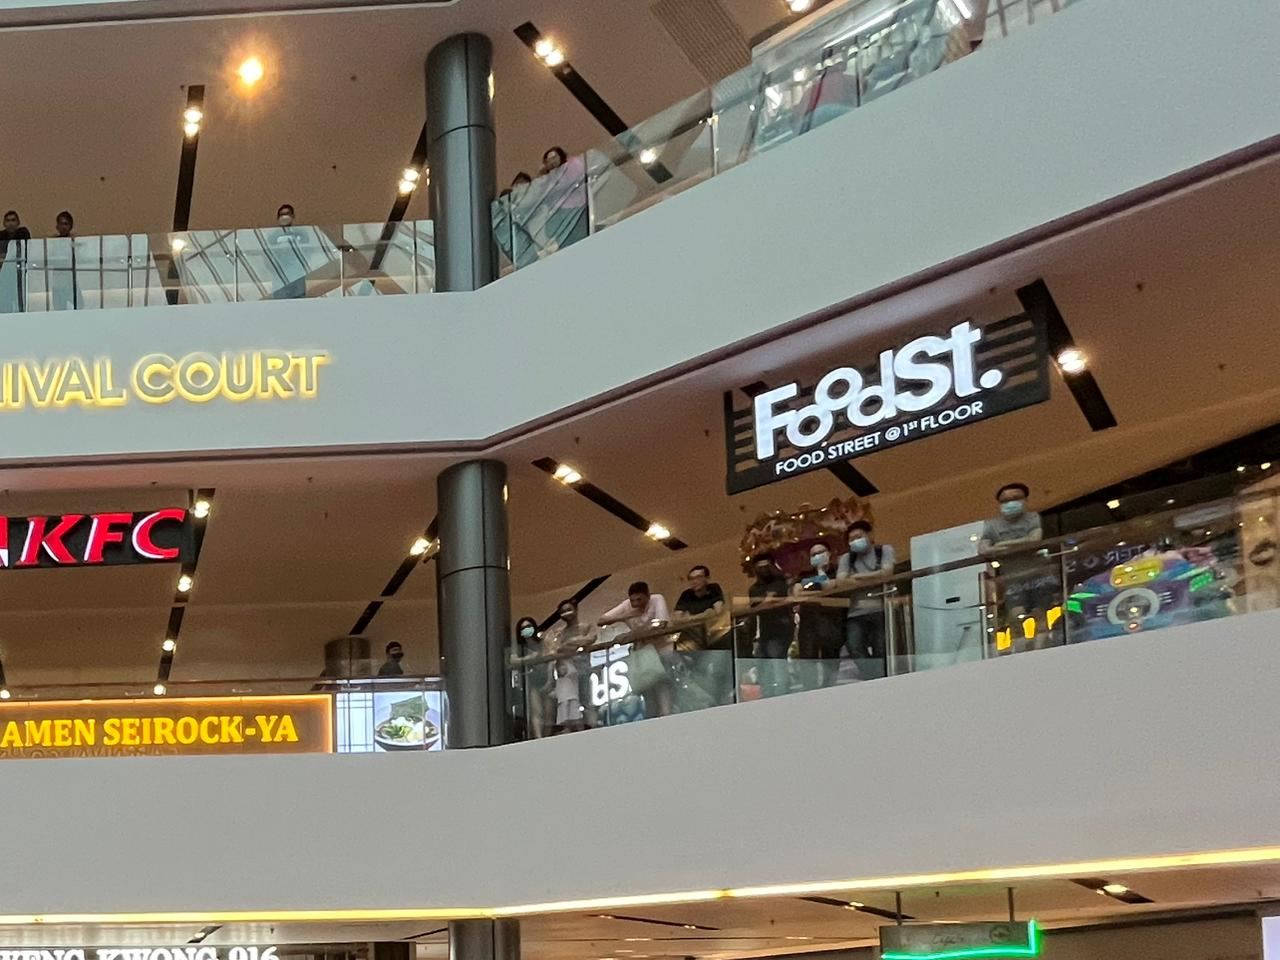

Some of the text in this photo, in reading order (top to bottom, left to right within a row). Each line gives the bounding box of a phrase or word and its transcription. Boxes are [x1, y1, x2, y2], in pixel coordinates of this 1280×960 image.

[134, 349, 332, 402] COURT
[775, 450, 825, 475] FOOD
[827, 431, 881, 459] STREET
[920, 401, 983, 432] FLOOR
[16, 508, 189, 565] KFC
[103, 714, 299, 746] SEIROCK-YA
